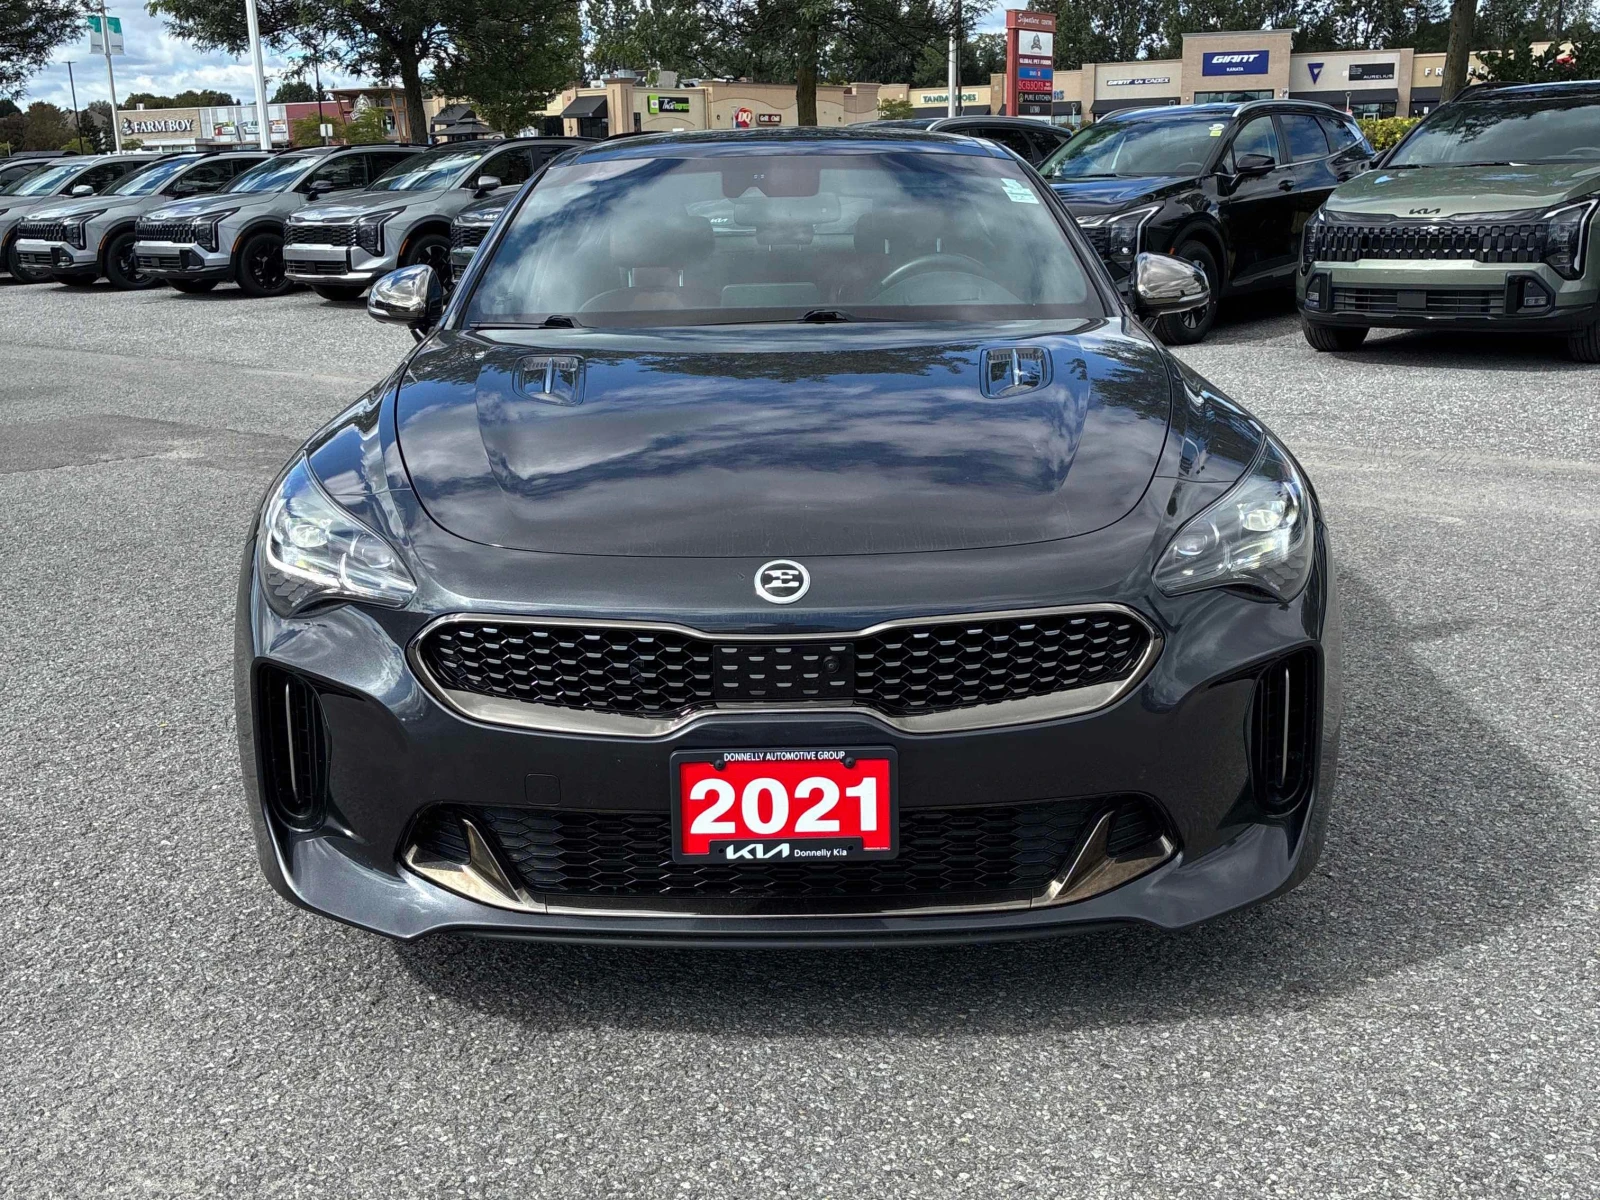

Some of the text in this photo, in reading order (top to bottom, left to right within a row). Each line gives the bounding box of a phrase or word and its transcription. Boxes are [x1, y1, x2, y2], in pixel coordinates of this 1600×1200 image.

[1211, 54, 1259, 64] GIANT
[738, 111, 751, 124] DQ
[134, 119, 194, 133] FARM BOY
[723, 750, 846, 762] DONNELLY AUTOMOTIVE GROUP
[689, 776, 878, 835] 2021
[725, 842, 847, 860] KIA Donnelly Kia
